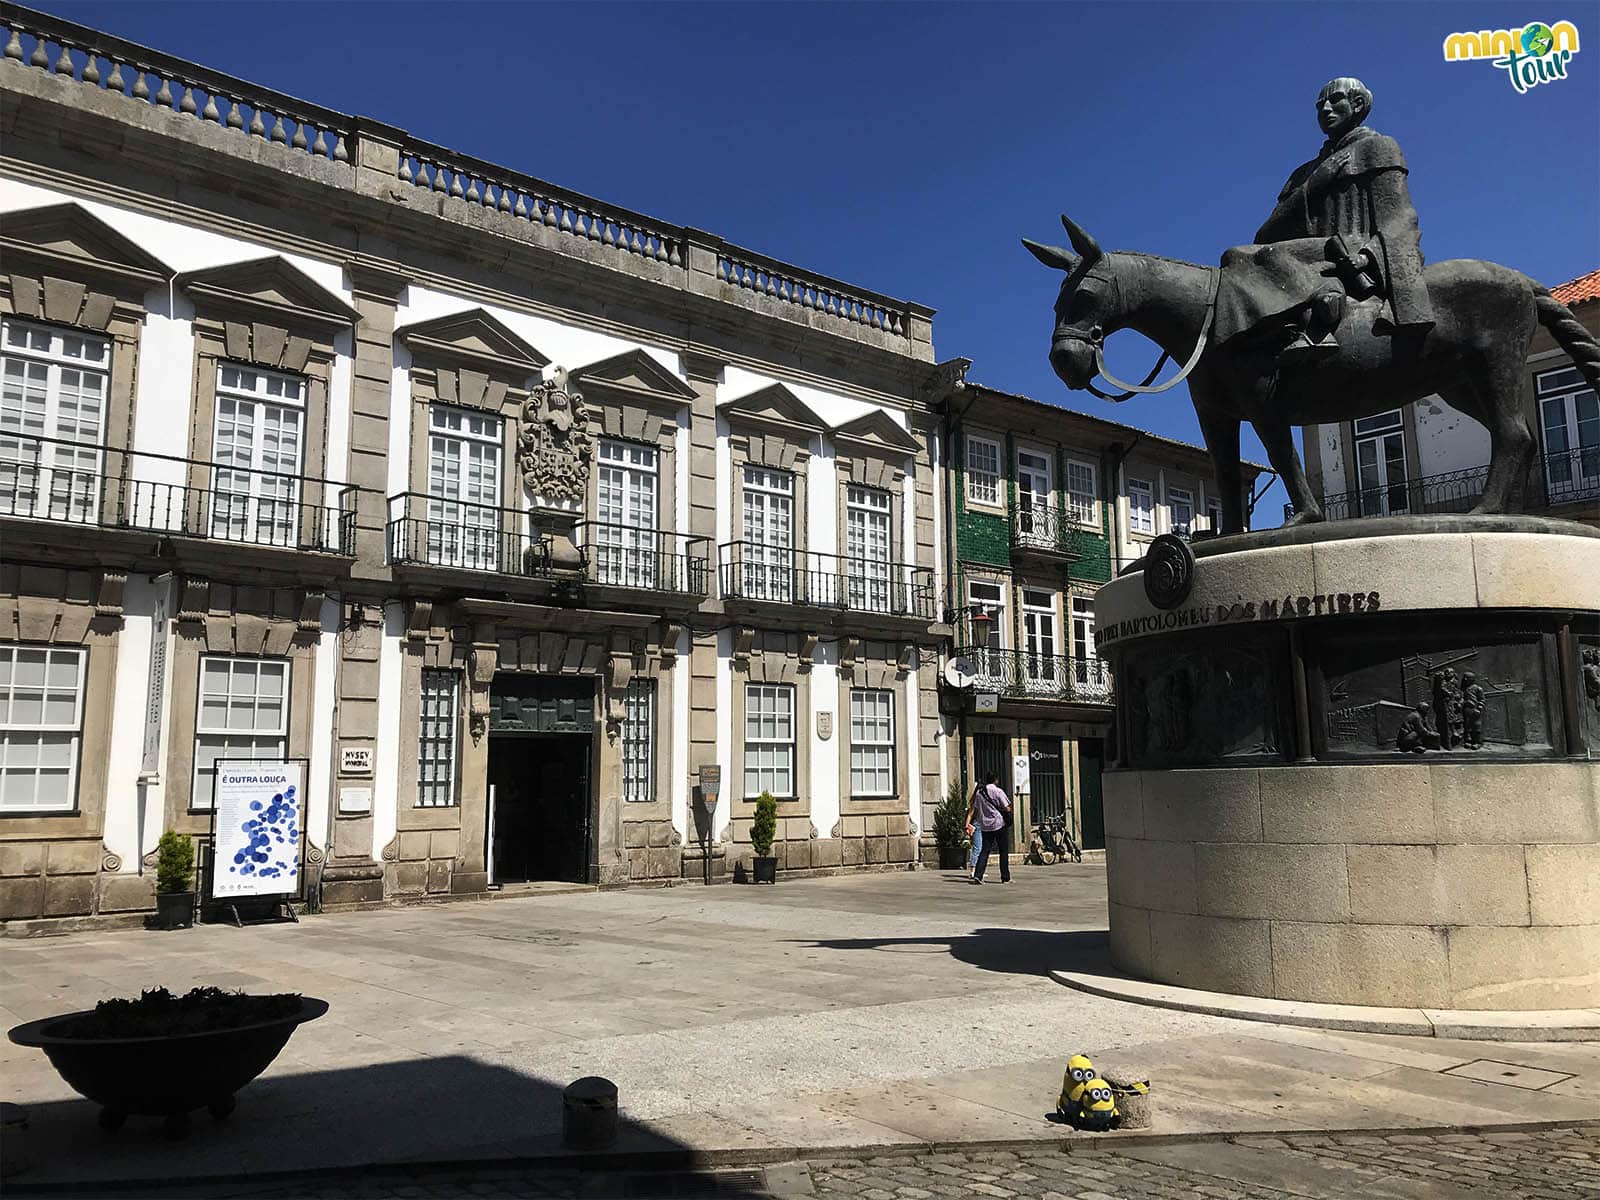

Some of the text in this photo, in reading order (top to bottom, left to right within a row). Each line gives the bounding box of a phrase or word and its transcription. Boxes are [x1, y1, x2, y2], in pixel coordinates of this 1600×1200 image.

[1120, 607, 1210, 637] BARTOLOMEU
[1216, 602, 1255, 622] DOS
[1260, 591, 1380, 619] MÁRTIRES
[222, 774, 287, 784] É OUTRA LOUÇA
